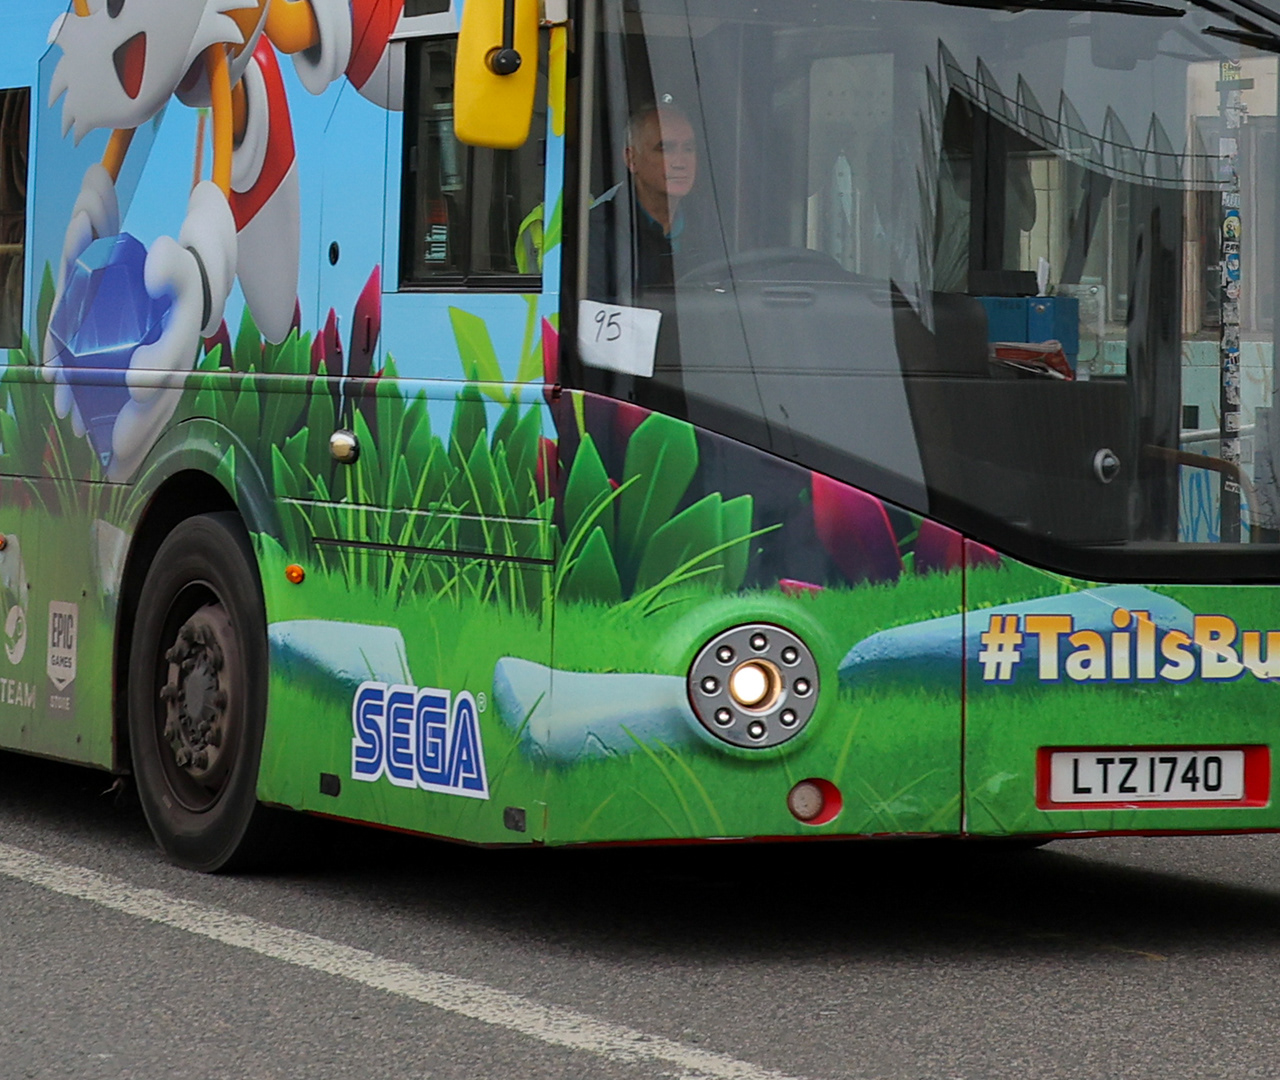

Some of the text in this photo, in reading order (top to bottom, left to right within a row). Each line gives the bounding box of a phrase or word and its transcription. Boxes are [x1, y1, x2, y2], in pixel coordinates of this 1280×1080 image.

[594, 309, 622, 342] 95
[51, 612, 75, 650] EPIC
[50, 655, 73, 669] GAMES
[352, 682, 489, 799] SEGA
[1072, 755, 1223, 795] LTZ 1740
